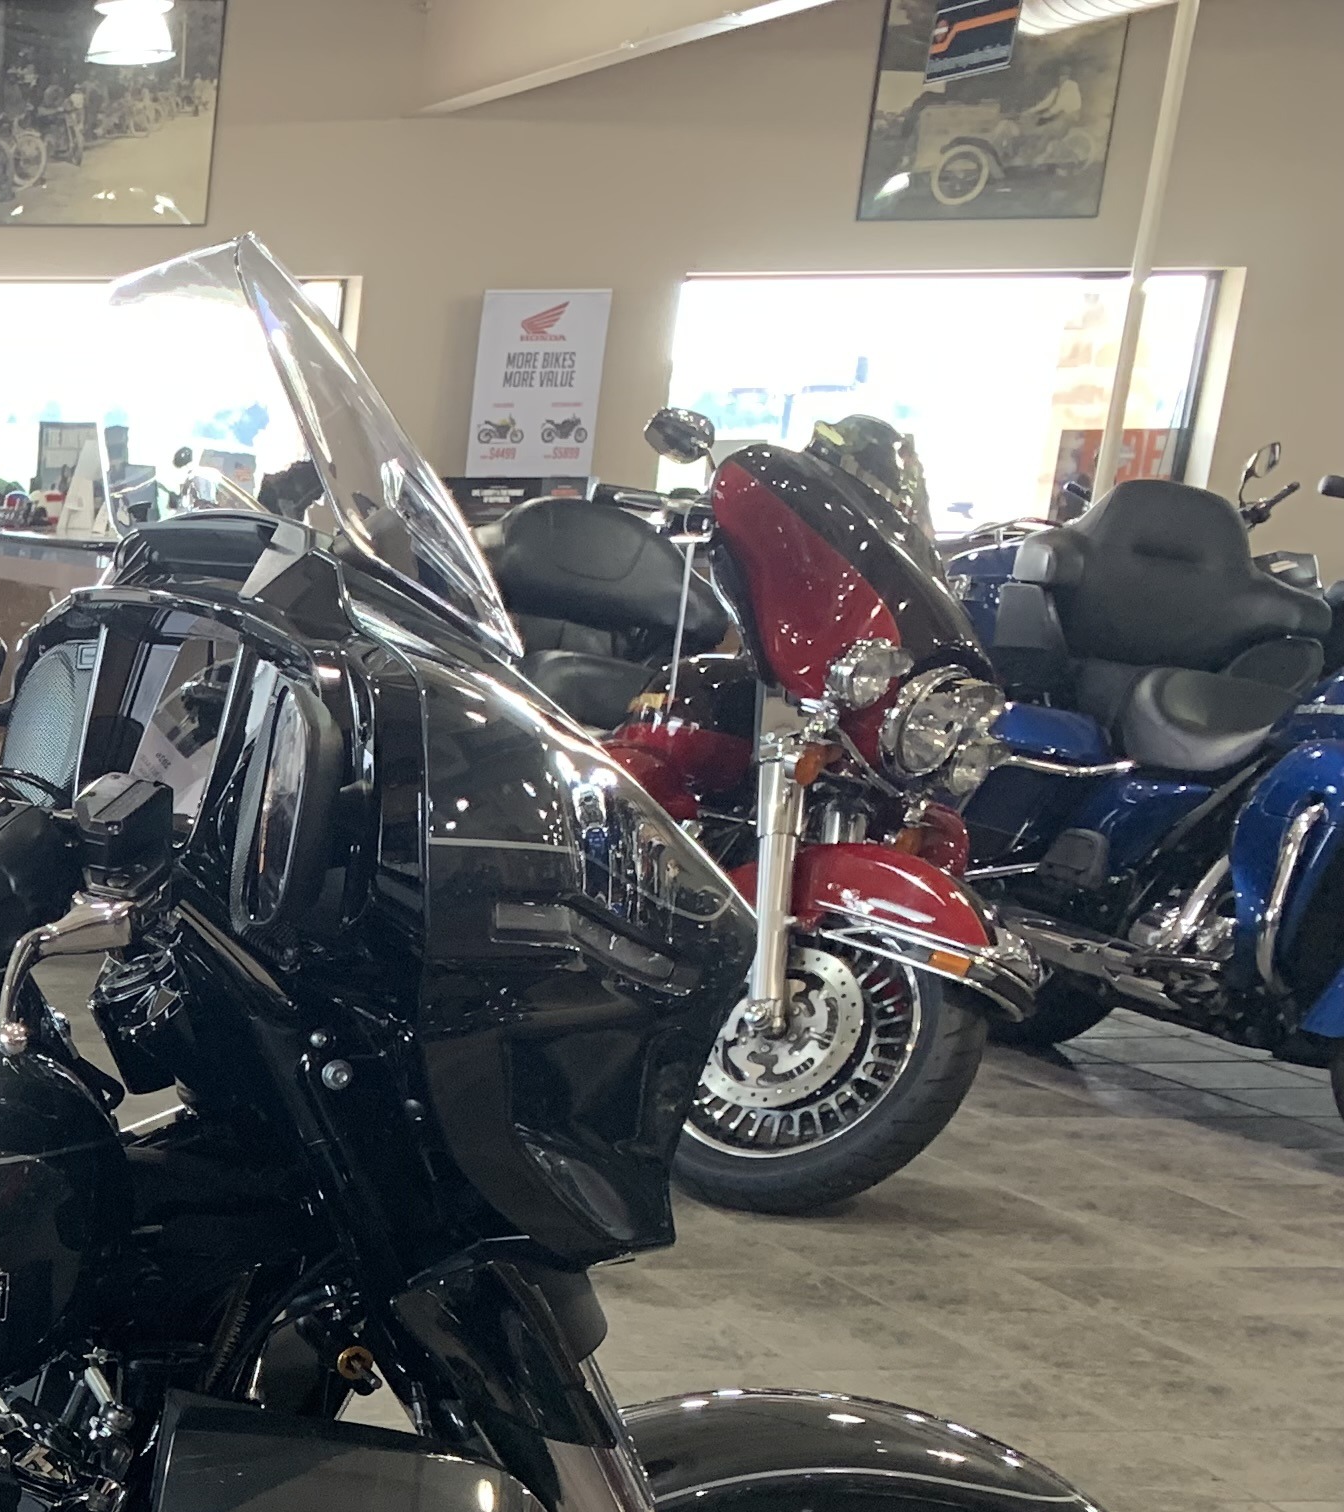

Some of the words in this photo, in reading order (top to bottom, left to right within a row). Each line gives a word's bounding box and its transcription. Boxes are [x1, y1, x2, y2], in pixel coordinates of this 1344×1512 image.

[519, 334, 567, 342] HONDA
[505, 351, 541, 370] MORE
[541, 351, 577, 370] BIKES
[502, 370, 537, 388] MORE
[538, 370, 577, 388] VALUE
